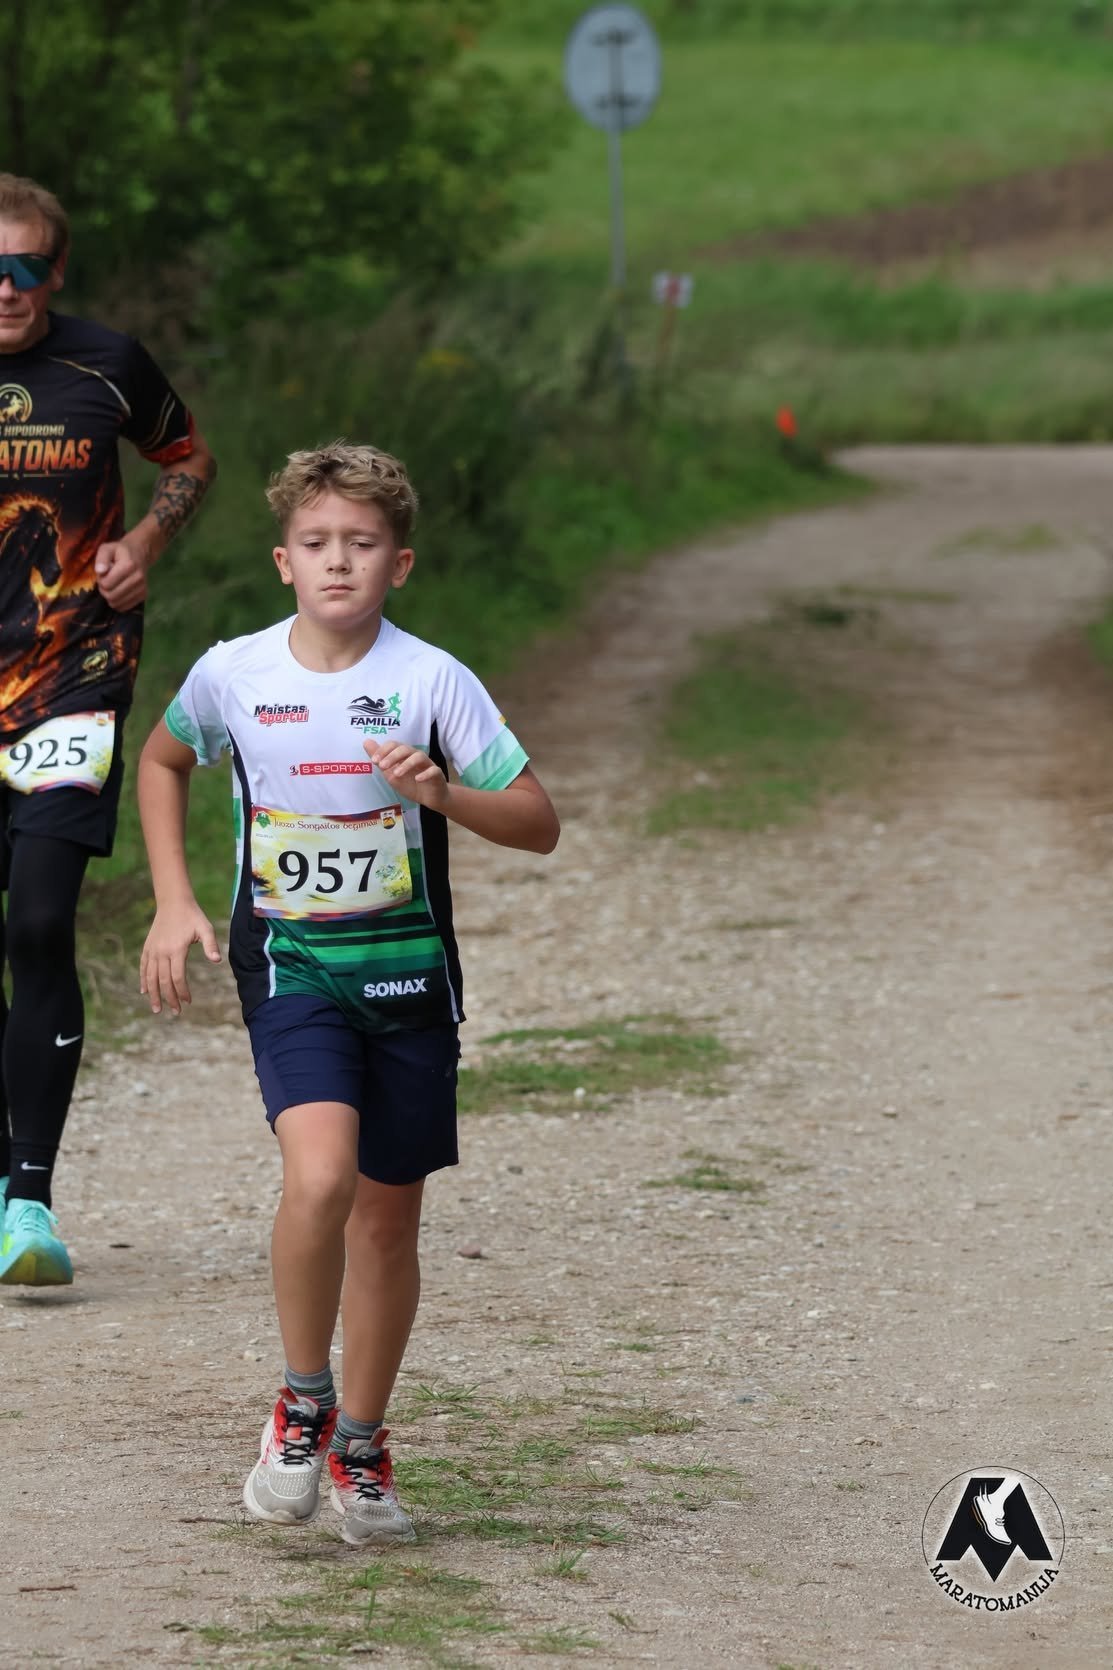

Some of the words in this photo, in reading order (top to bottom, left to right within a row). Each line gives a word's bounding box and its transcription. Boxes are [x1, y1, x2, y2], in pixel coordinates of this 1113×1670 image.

[4, 424, 65, 437] HIPODROMO
[254, 703, 306, 717] Maistas
[259, 709, 309, 727] Sportui
[350, 717, 401, 727] FAMILIA
[363, 726, 388, 735] FSA
[9, 734, 88, 775] 925
[302, 764, 370, 774] S-SPORTAS
[278, 848, 378, 894] 957
[363, 977, 428, 998] SONAX
